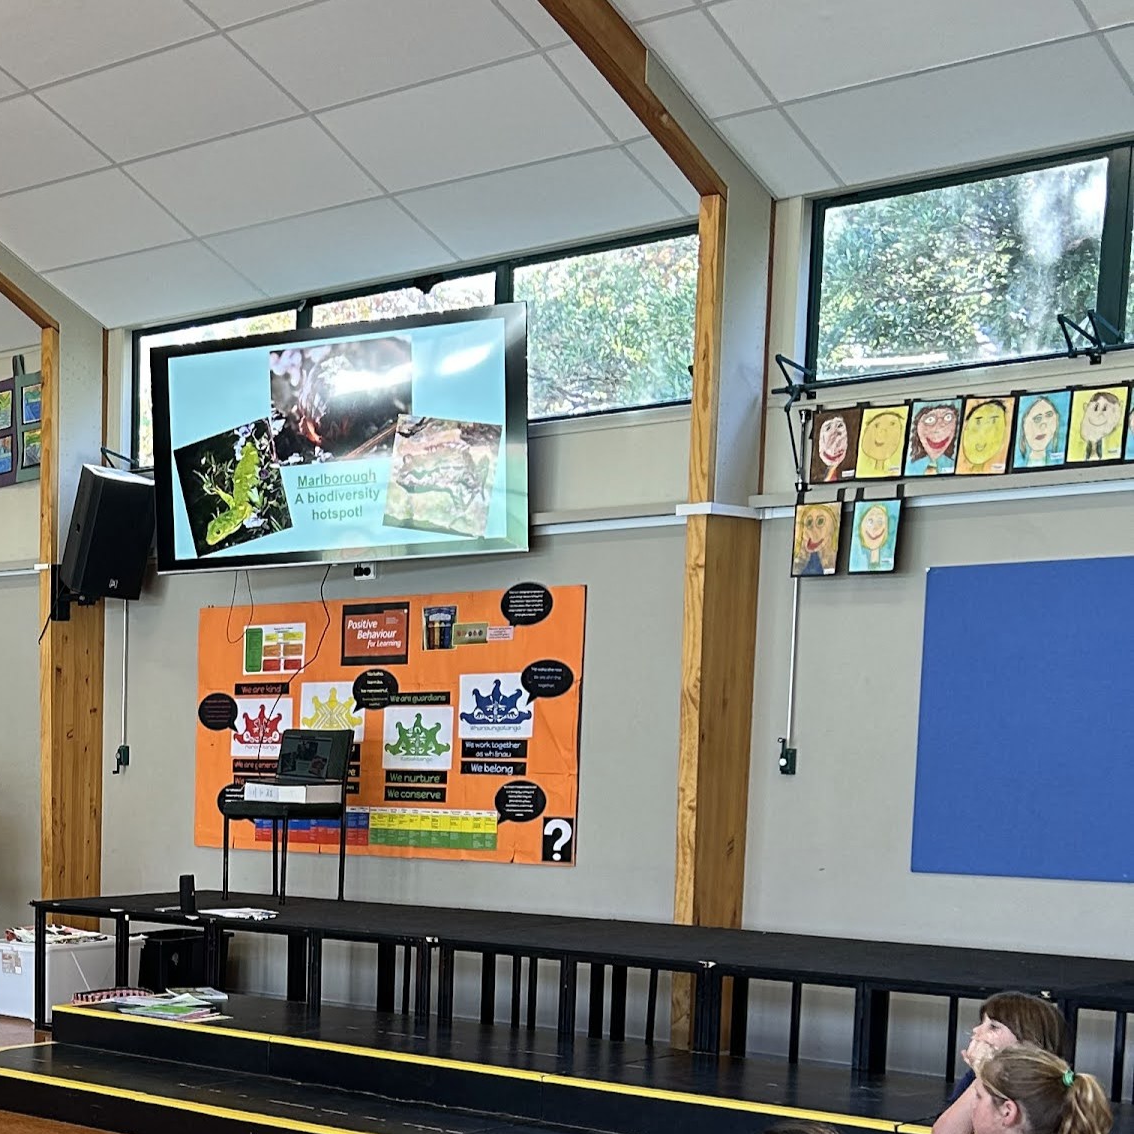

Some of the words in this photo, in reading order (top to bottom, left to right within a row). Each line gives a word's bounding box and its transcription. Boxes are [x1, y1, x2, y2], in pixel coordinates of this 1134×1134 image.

[297, 469, 376, 488] Marlborough
[294, 493, 304, 504] A
[307, 487, 380, 503] biodiversity
[312, 505, 363, 521] hotspot!
[347, 619, 378, 629] Positive
[357, 629, 397, 640] Behaviour
[367, 640, 376, 649] for
[376, 640, 402, 648] Learning
[241, 685, 252, 694] We
[266, 685, 282, 693] kind
[412, 693, 446, 704] guardians
[465, 741, 474, 749] We
[491, 741, 521, 750] together
[234, 761, 244, 769] We
[470, 763, 483, 773] We
[483, 763, 514, 776] belong
[389, 772, 402, 782] We
[403, 774, 441, 783] nurture
[387, 788, 400, 798] We
[400, 790, 442, 799] conserve
[543, 819, 572, 861] ?
